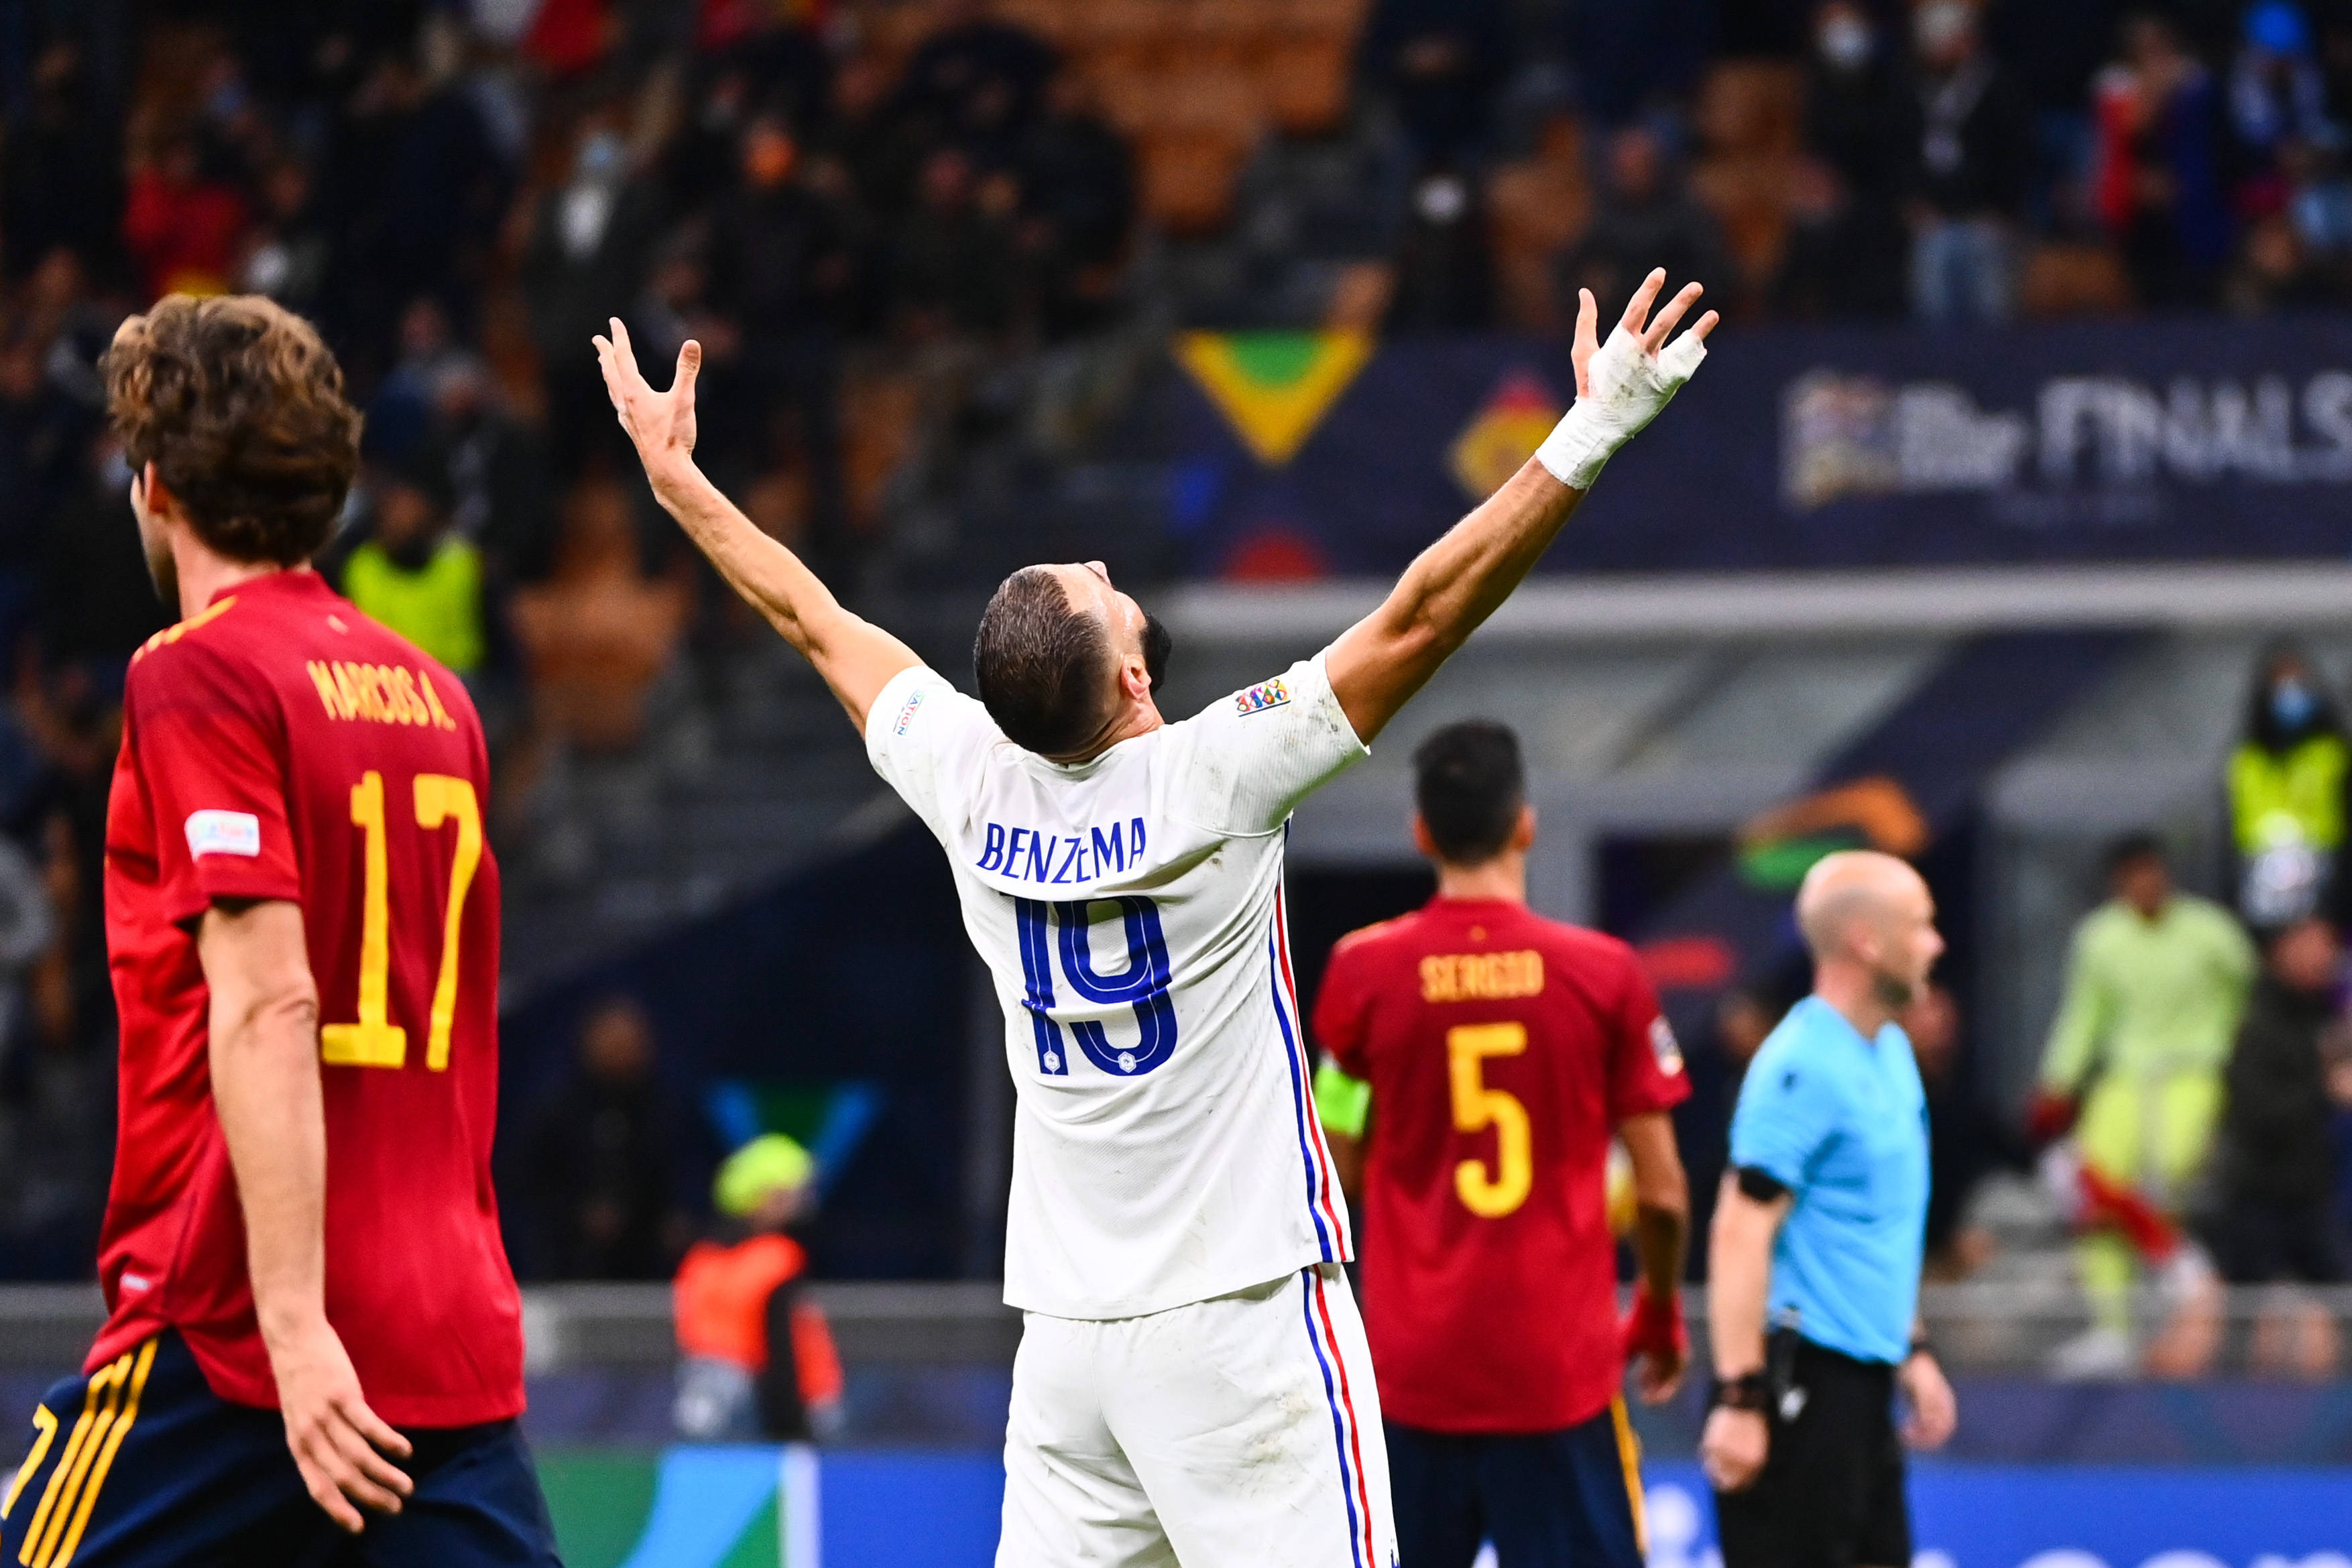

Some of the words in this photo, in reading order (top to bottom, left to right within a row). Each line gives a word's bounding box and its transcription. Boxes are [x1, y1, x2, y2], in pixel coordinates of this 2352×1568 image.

[306, 660, 430, 727] MARCOS
[976, 816, 1146, 884] BENZEMA
[320, 769, 483, 1072] 17
[1419, 949, 1545, 1004] SERGIO
[1009, 894, 1179, 1077] 19
[1446, 1020, 1534, 1219] 5
